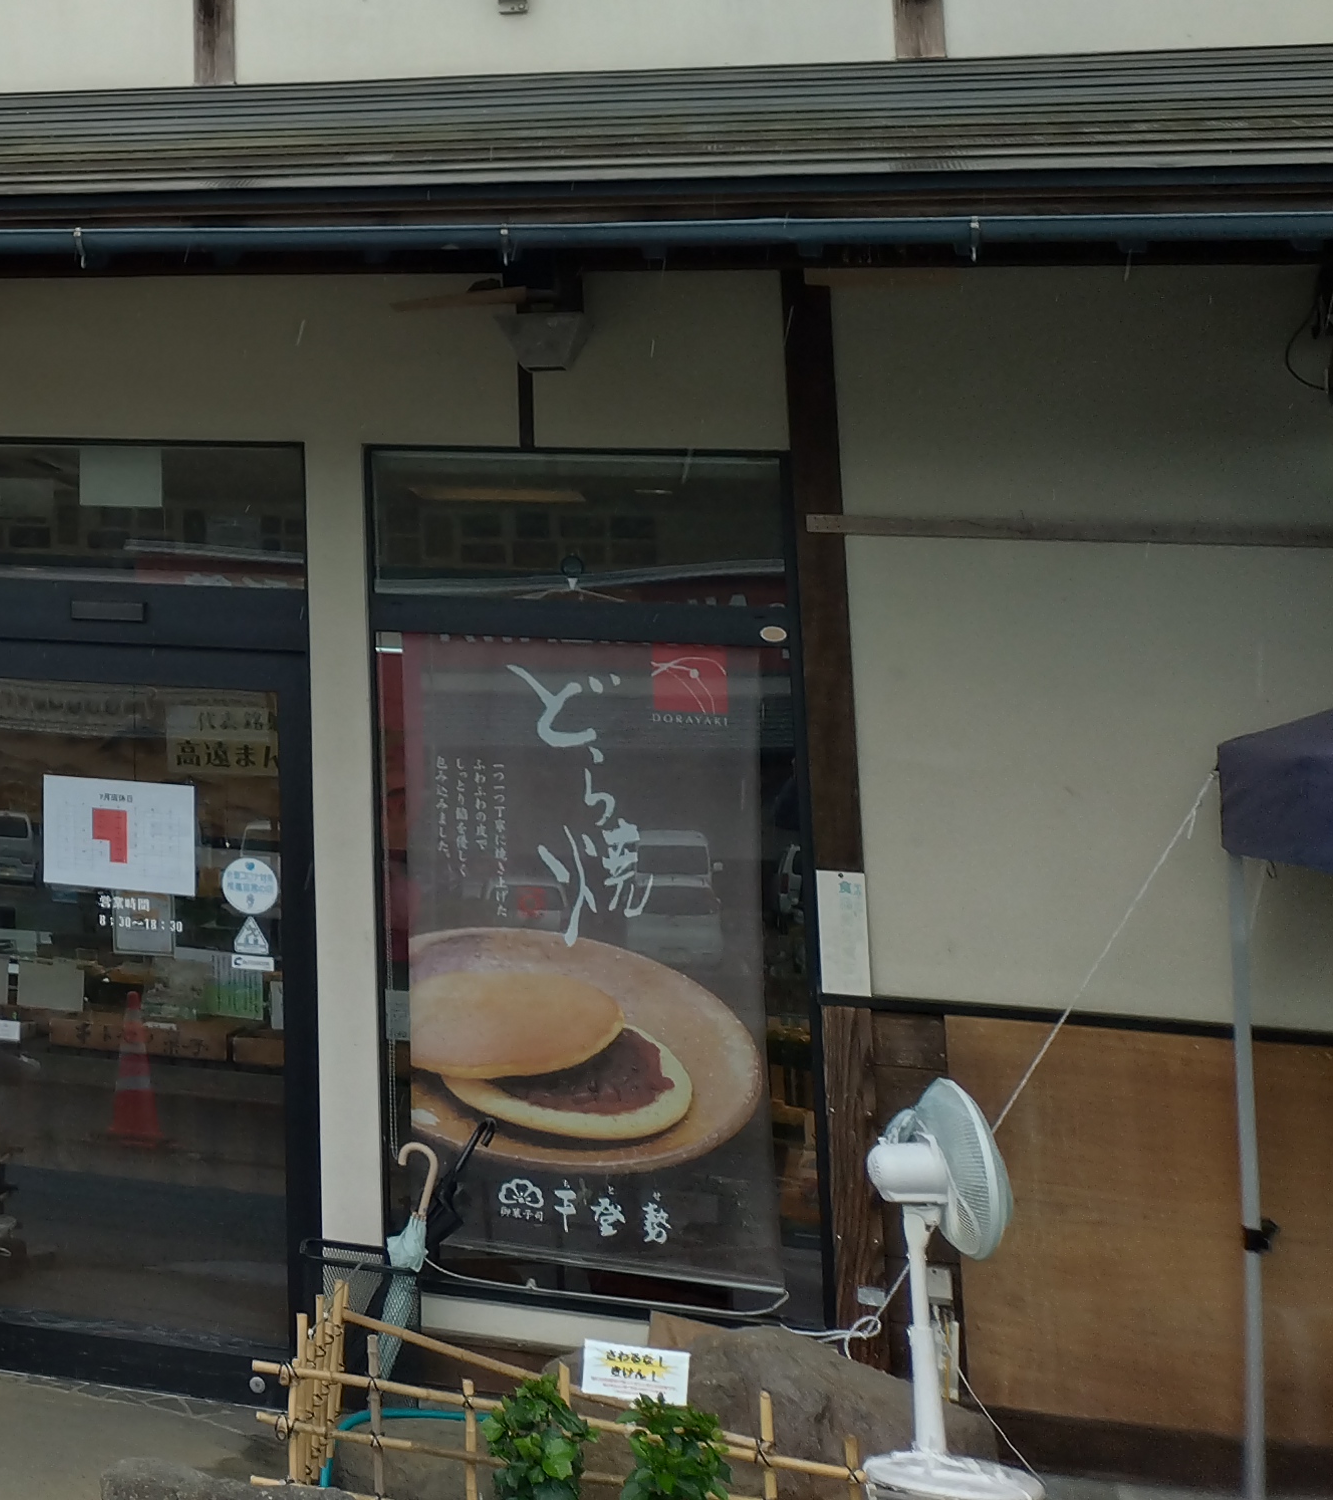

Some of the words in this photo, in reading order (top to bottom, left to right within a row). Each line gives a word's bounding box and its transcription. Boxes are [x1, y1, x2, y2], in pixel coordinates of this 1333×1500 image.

[652, 712, 729, 727] DORAYAKI
[473, 759, 487, 850] ふわふわの皮で
[98, 894, 151, 913] 営業時間
